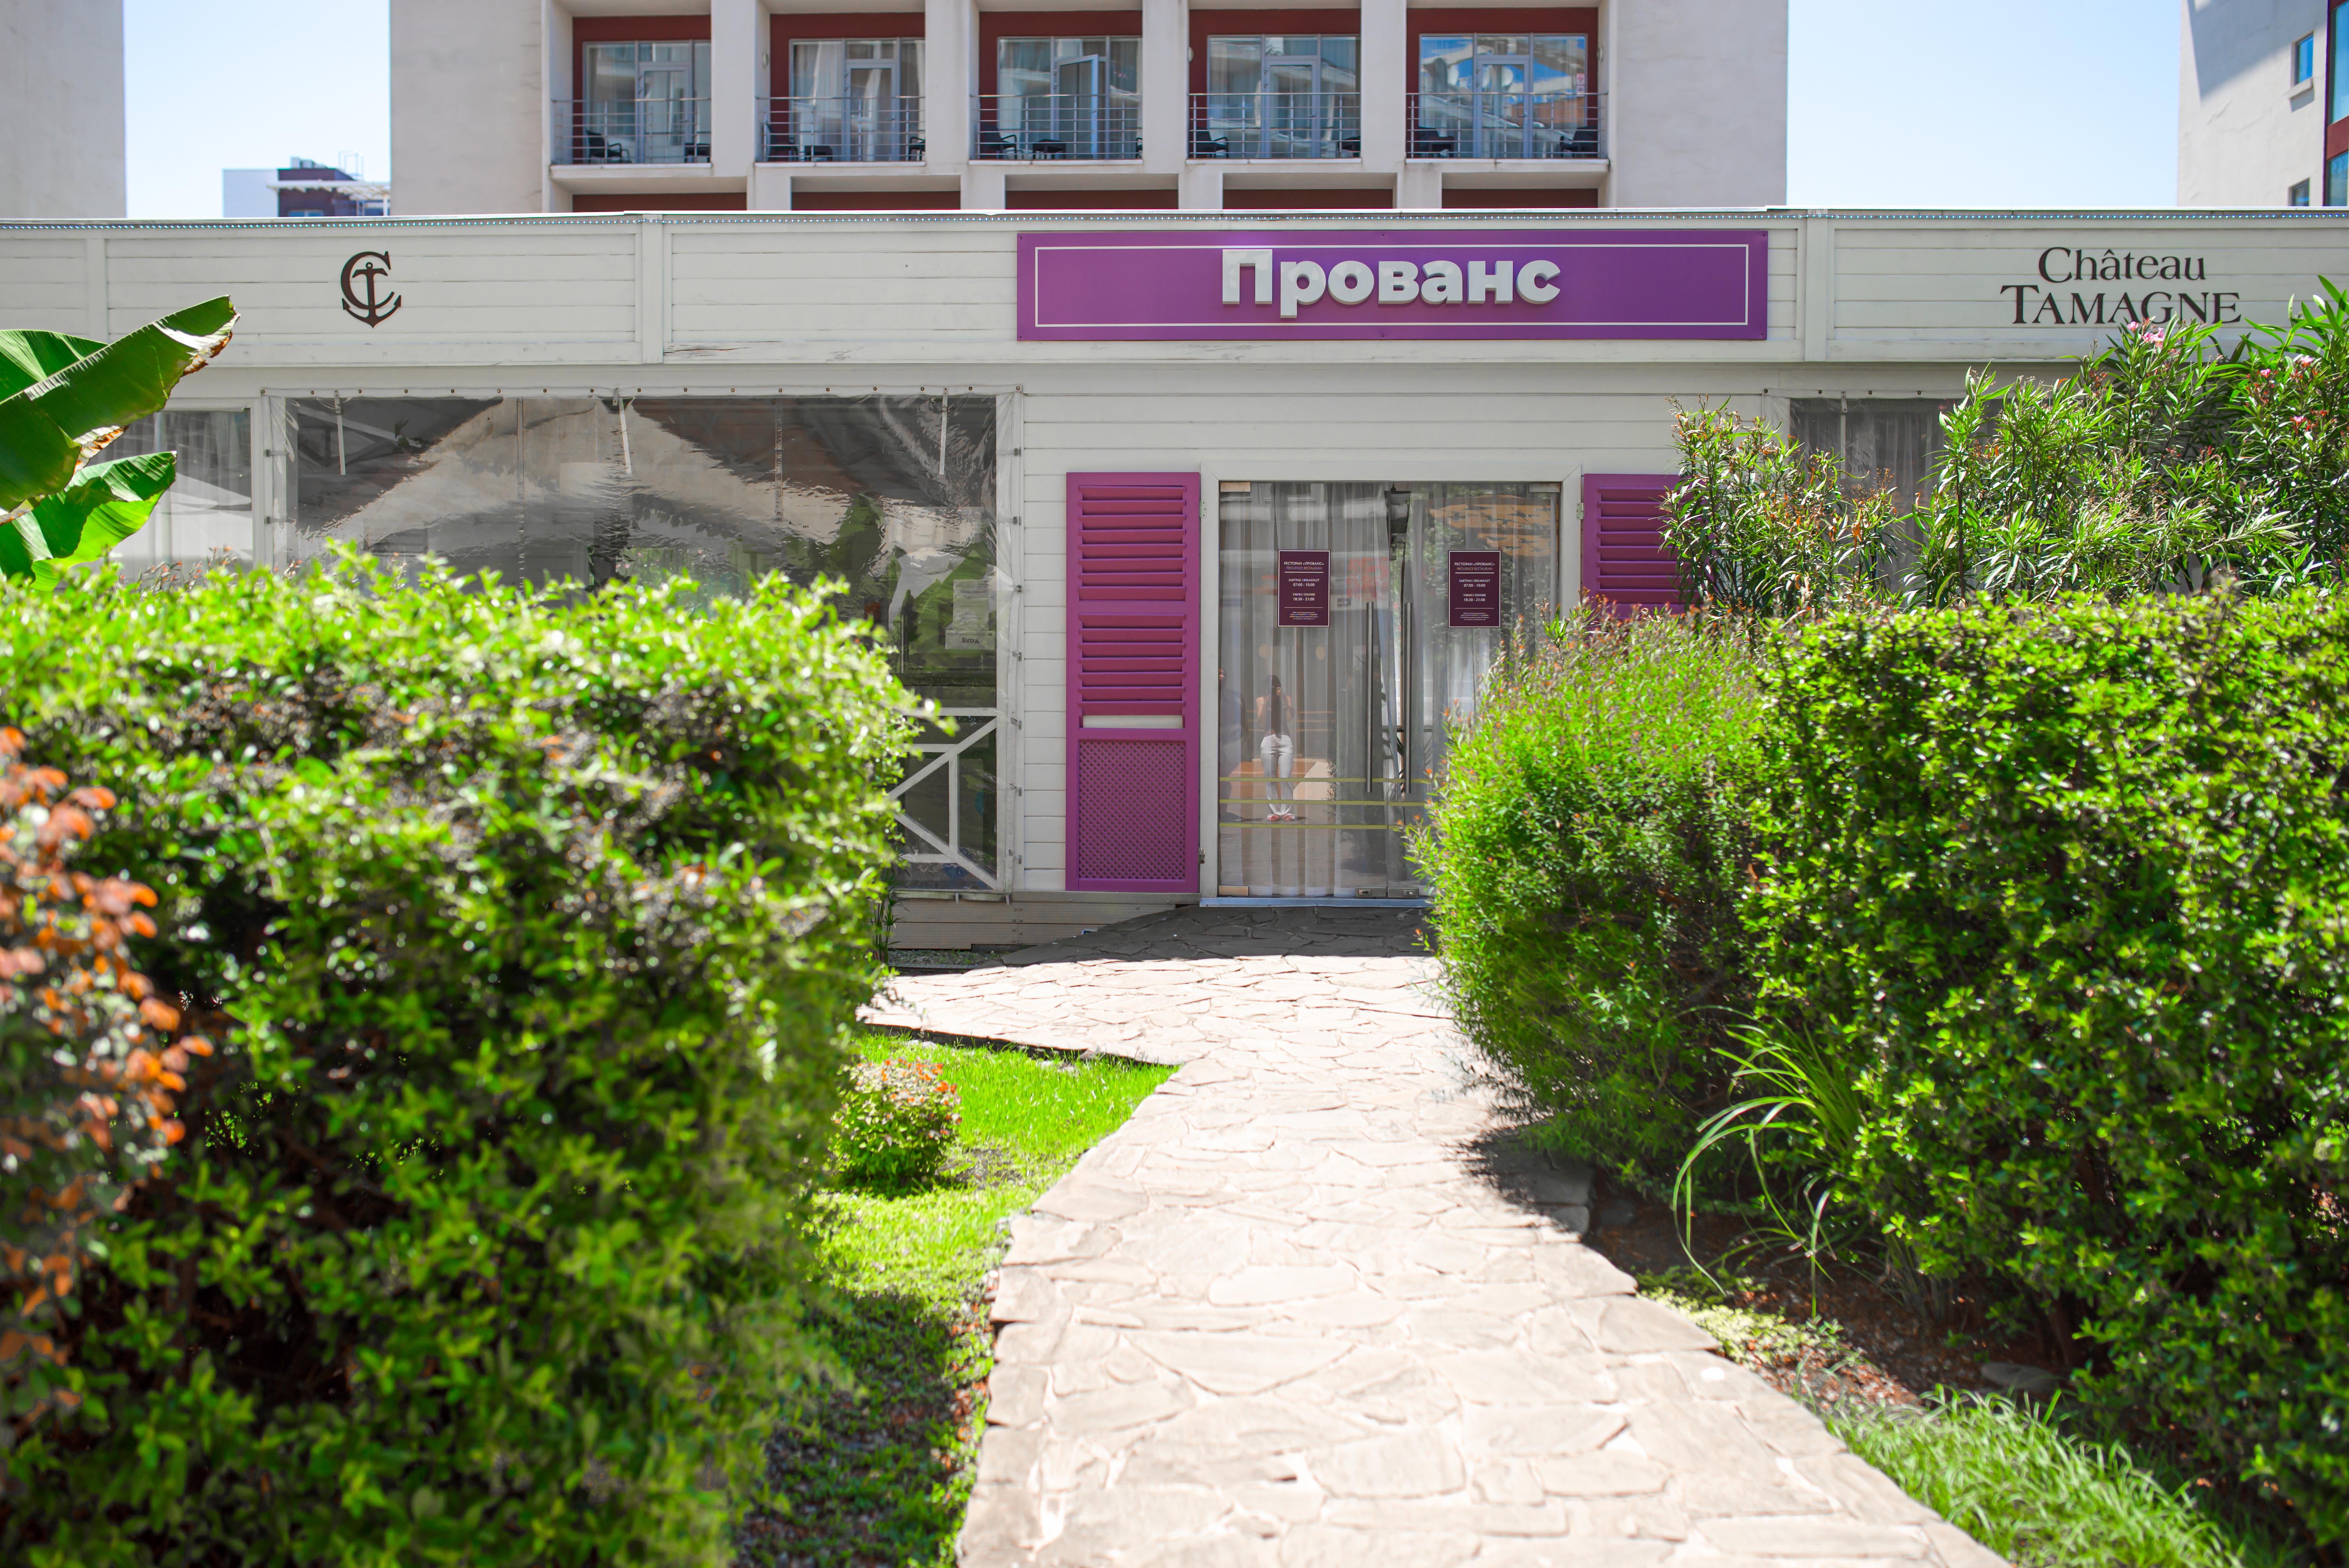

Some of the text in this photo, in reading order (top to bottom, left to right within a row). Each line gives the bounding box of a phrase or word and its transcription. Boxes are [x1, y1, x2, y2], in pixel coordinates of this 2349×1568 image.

[1222, 249, 1561, 319] Прованс
[2038, 246, 2207, 283] Château
[2000, 285, 2242, 324] TAMAGNE
